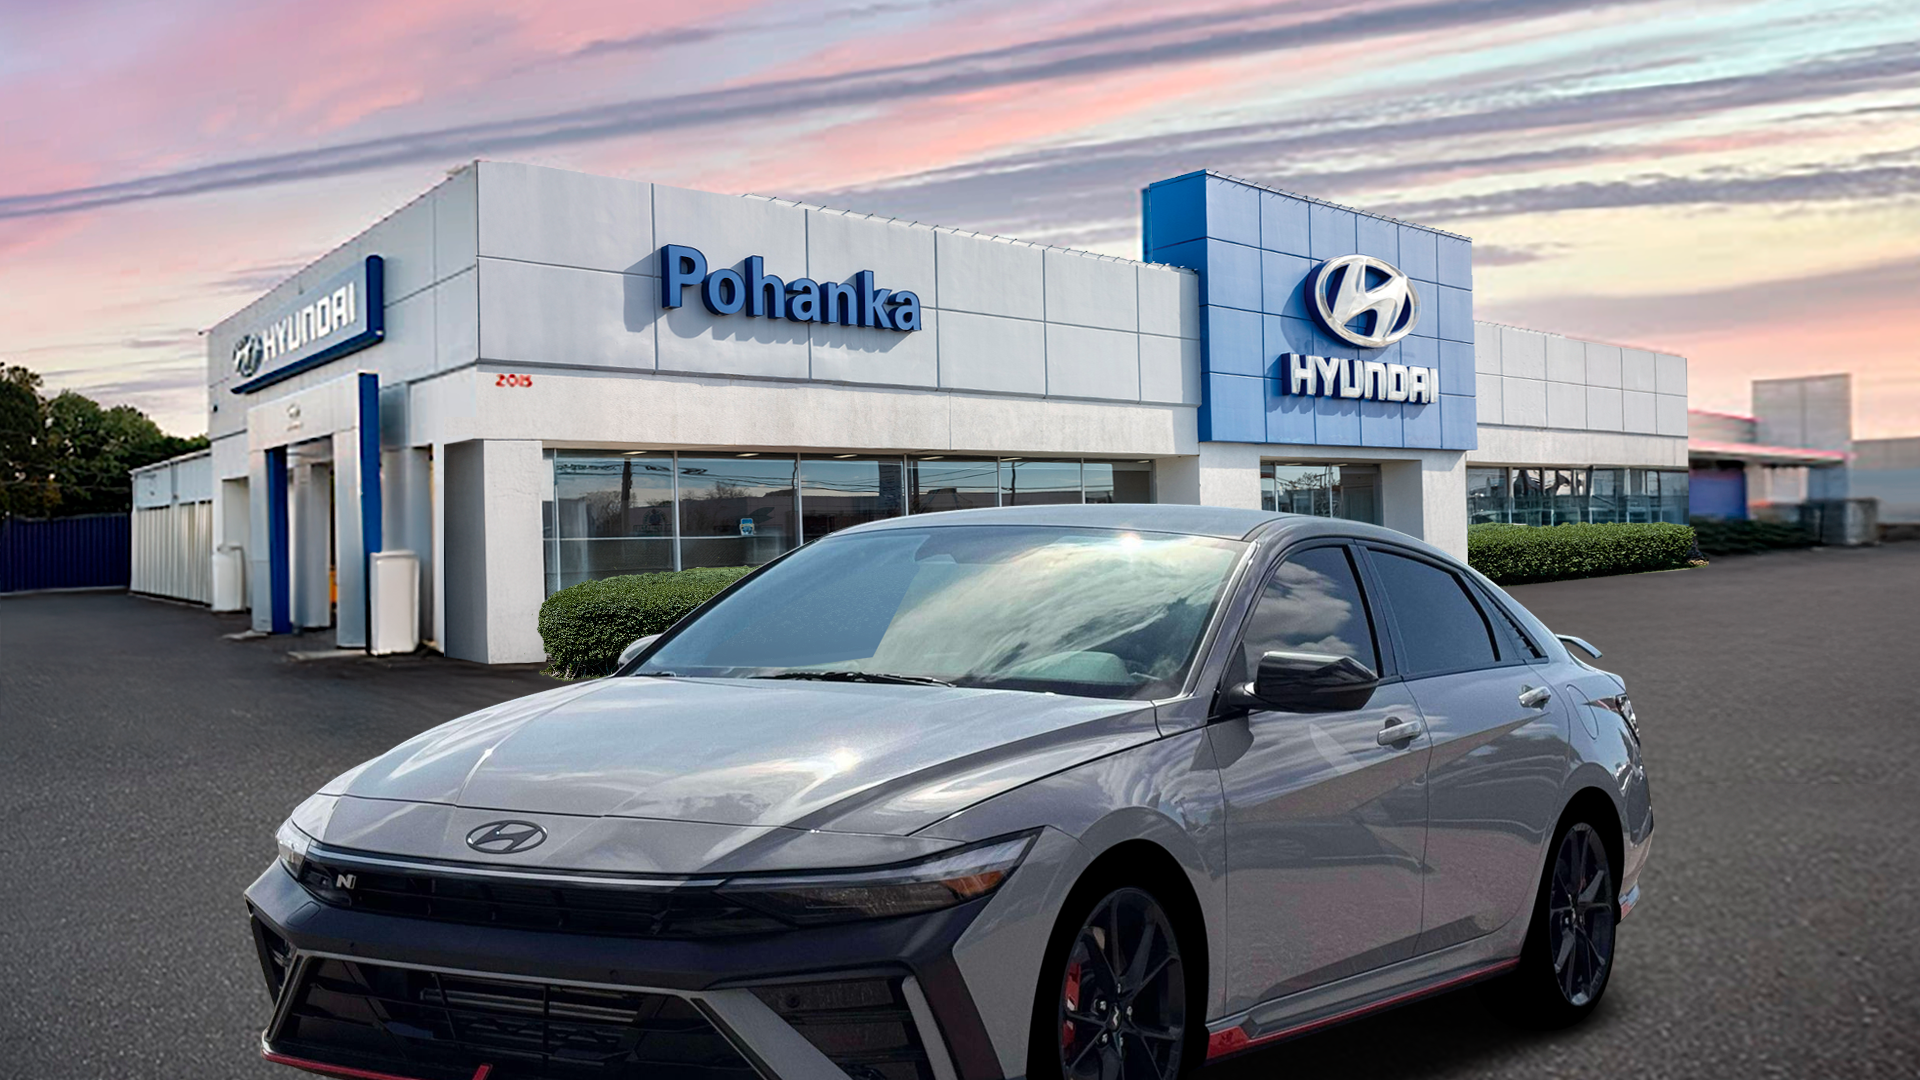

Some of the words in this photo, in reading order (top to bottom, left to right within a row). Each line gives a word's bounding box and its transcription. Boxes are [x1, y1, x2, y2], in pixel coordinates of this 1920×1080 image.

[262, 282, 357, 362] HYUNDAI
[661, 244, 922, 332] Pohanka
[1281, 352, 1439, 404] HYUNDAI
